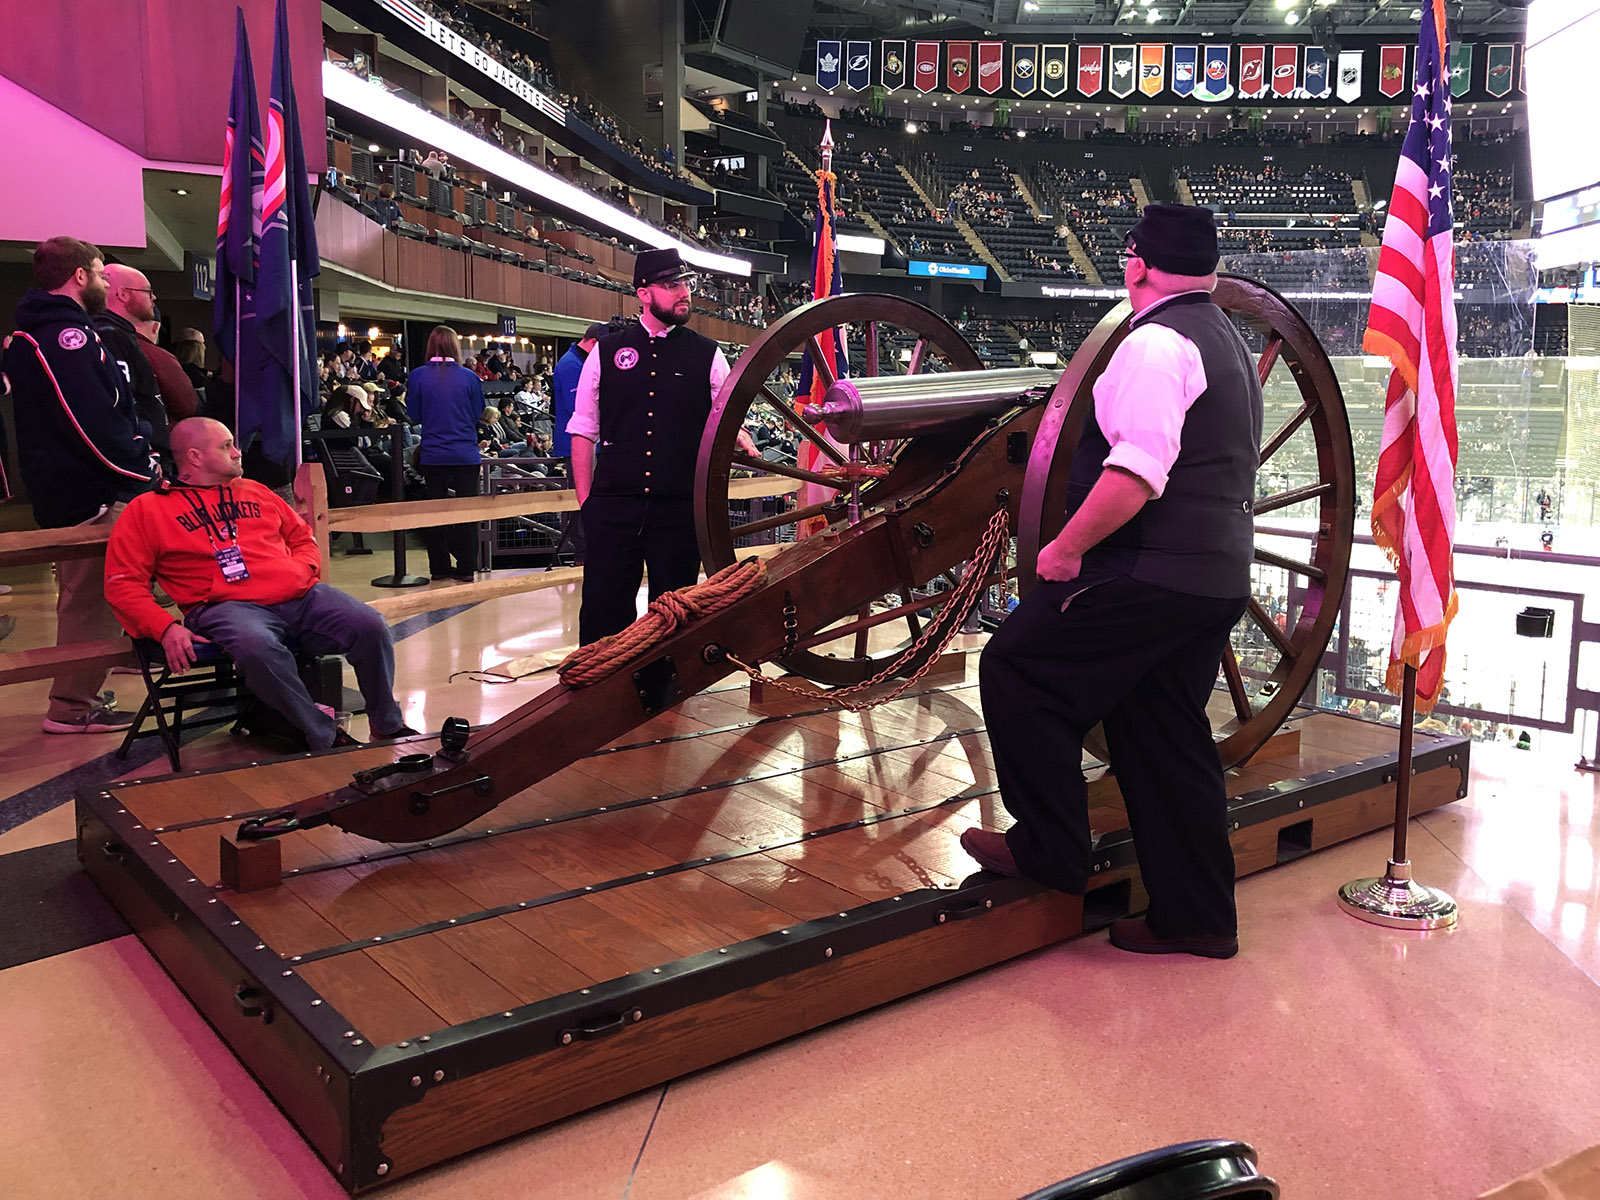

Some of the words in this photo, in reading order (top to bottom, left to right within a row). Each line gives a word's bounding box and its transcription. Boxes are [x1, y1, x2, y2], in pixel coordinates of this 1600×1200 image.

[429, 20, 466, 57] LET'S
[474, 50, 488, 71] GO
[493, 66, 541, 107] JACKETS
[195, 263, 209, 293] 112
[504, 319, 515, 334] 113
[211, 501, 261, 522] JKETS
